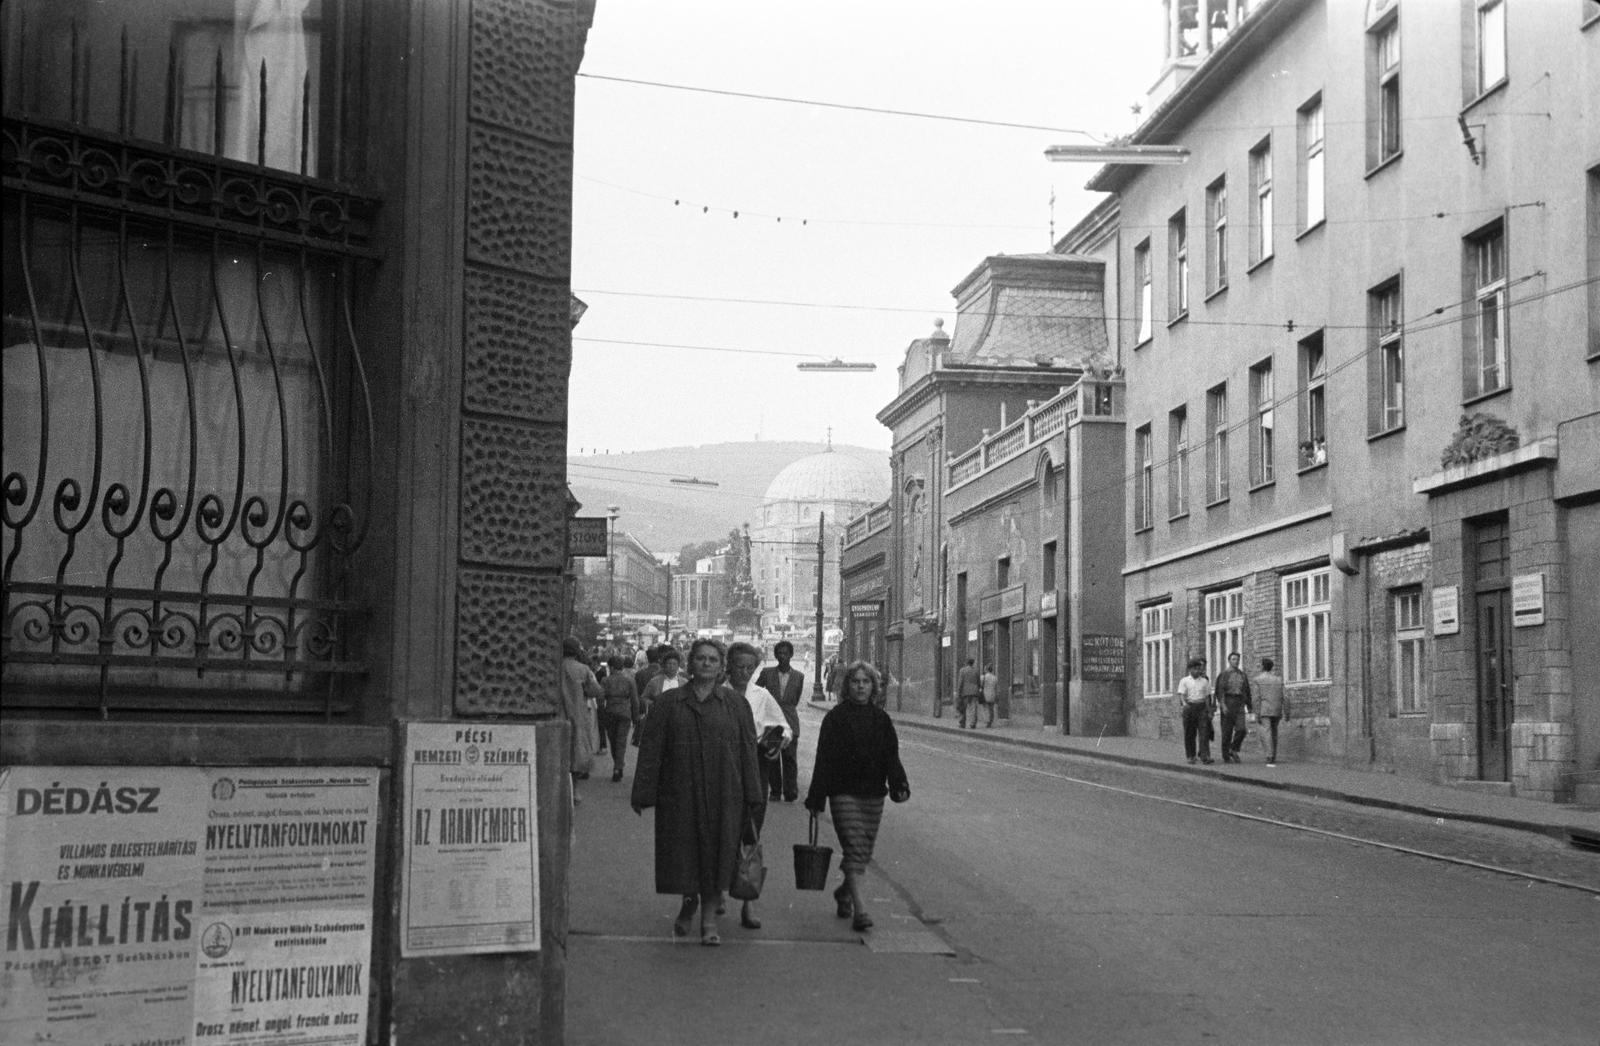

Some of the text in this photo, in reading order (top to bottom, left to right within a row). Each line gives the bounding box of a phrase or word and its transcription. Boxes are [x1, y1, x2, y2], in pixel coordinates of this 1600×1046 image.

[456, 728, 493, 743] PÉCSI
[414, 748, 529, 763] NEMZETI SZÍNHÁZ
[16, 781, 160, 819] DÉDÁSZ
[205, 820, 367, 851] NYELVTANFOLYAMOKAT
[415, 807, 527, 846] AZ ARANYEMBER
[60, 843, 107, 860] VILLAMOS
[110, 840, 197, 858] BALESETELHÁRÍTÁSI
[57, 861, 145, 880] ÉS MUNKAVÉDELMI
[231, 963, 362, 1005] NYELVTANFOLYAMOK
[334, 1011, 360, 1026] olasz
